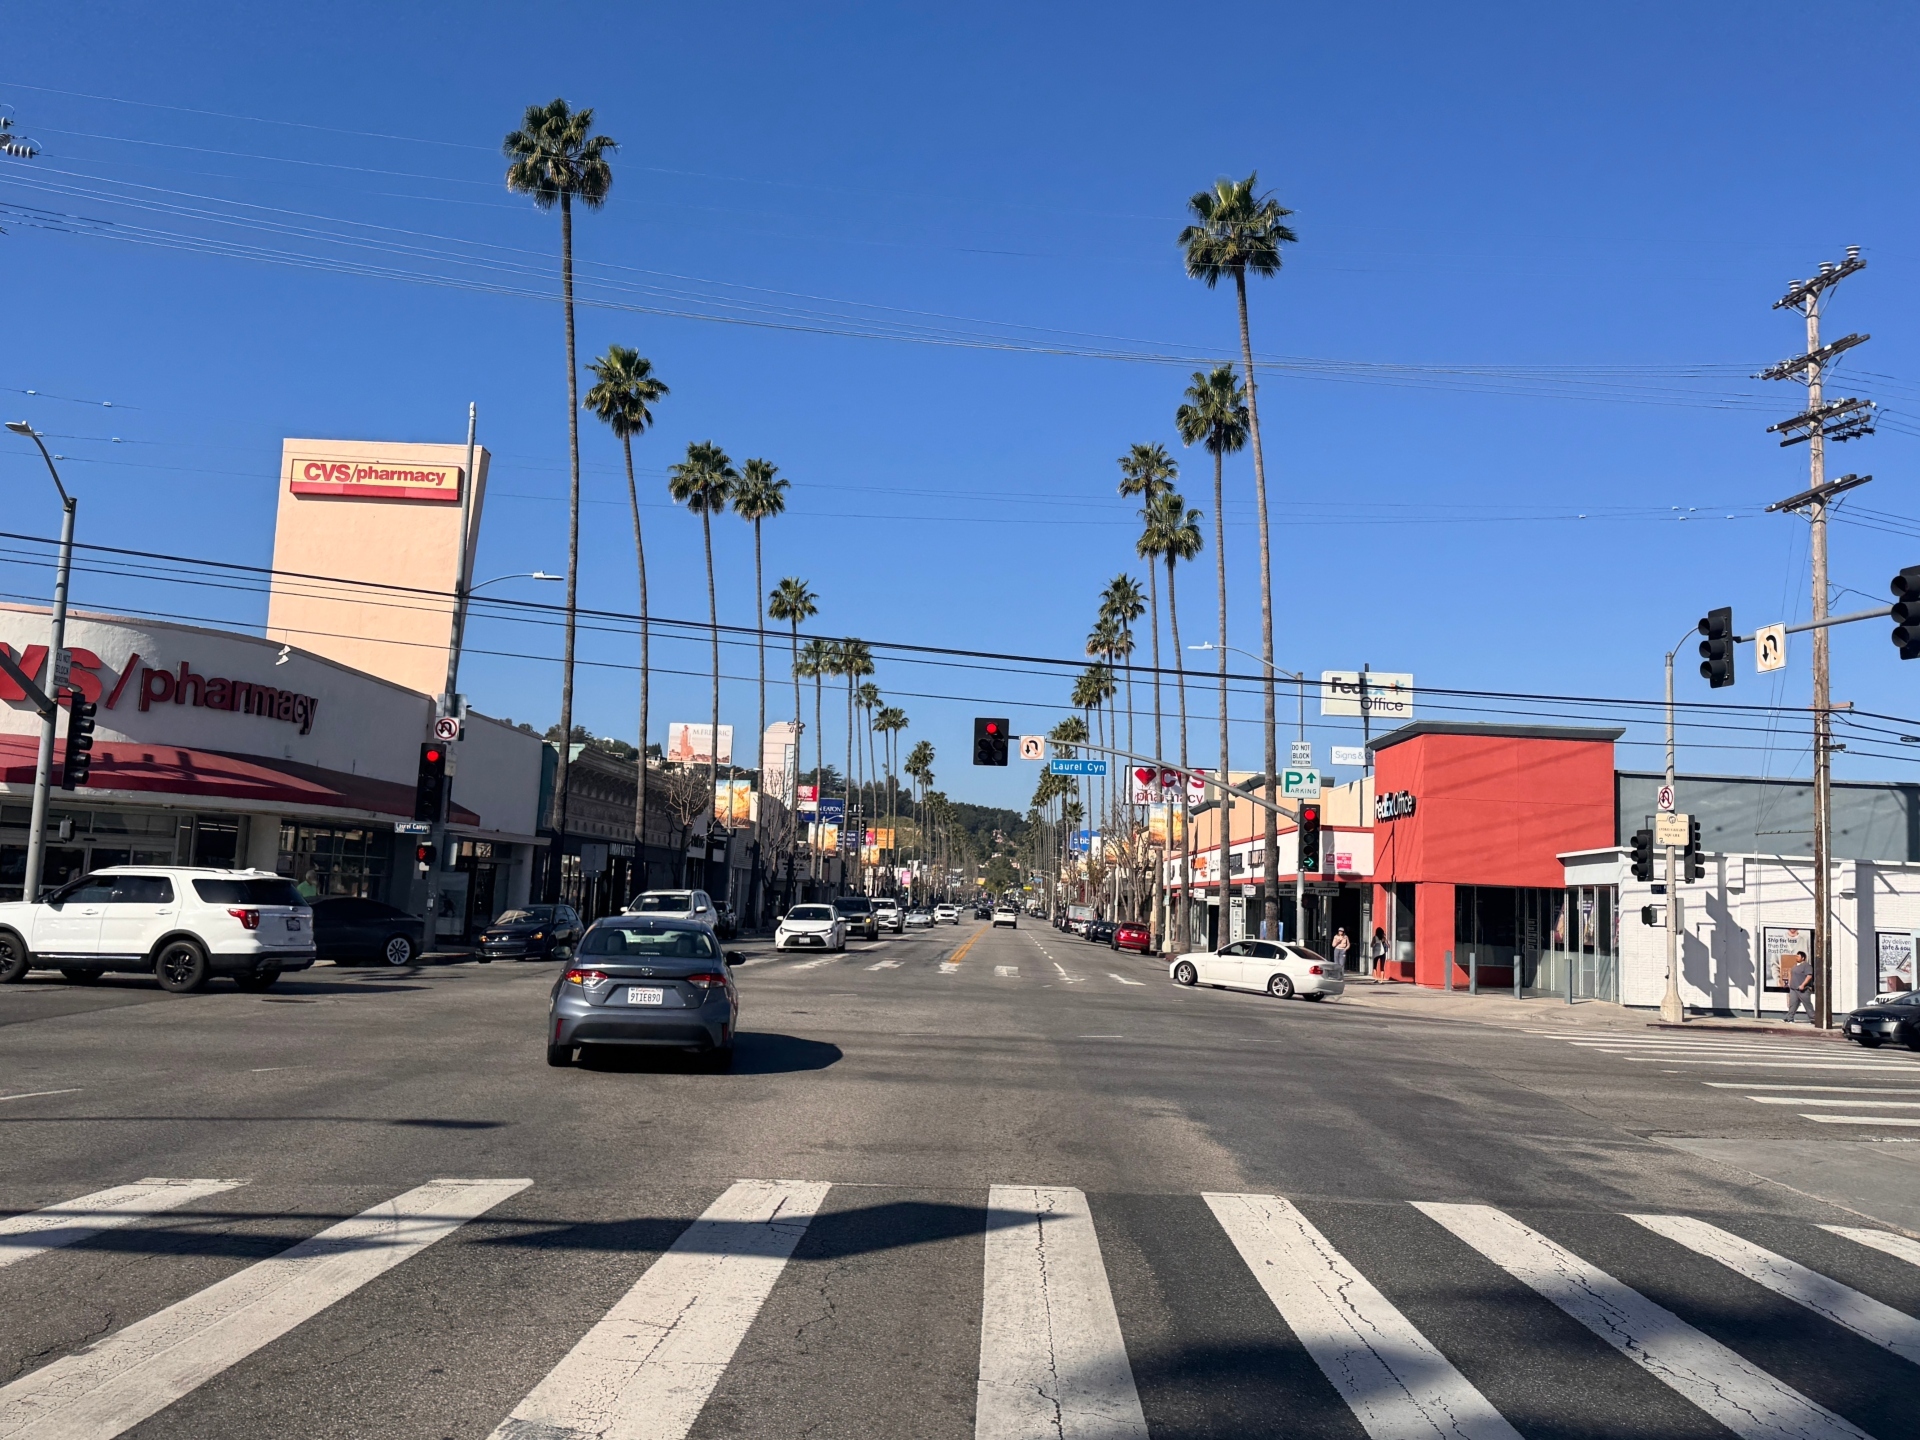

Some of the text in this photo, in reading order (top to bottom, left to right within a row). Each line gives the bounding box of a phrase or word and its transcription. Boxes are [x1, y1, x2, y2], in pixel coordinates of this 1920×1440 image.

[303, 462, 446, 486] CVS/pharmacy
[1332, 677, 1386, 696] FedEx
[1361, 697, 1404, 711] Office
[1335, 750, 1357, 760] Signs
[1358, 751, 1364, 759] &
[1053, 761, 1105, 773] Laurel Cyn
[1376, 790, 1413, 819] FedEx Office
